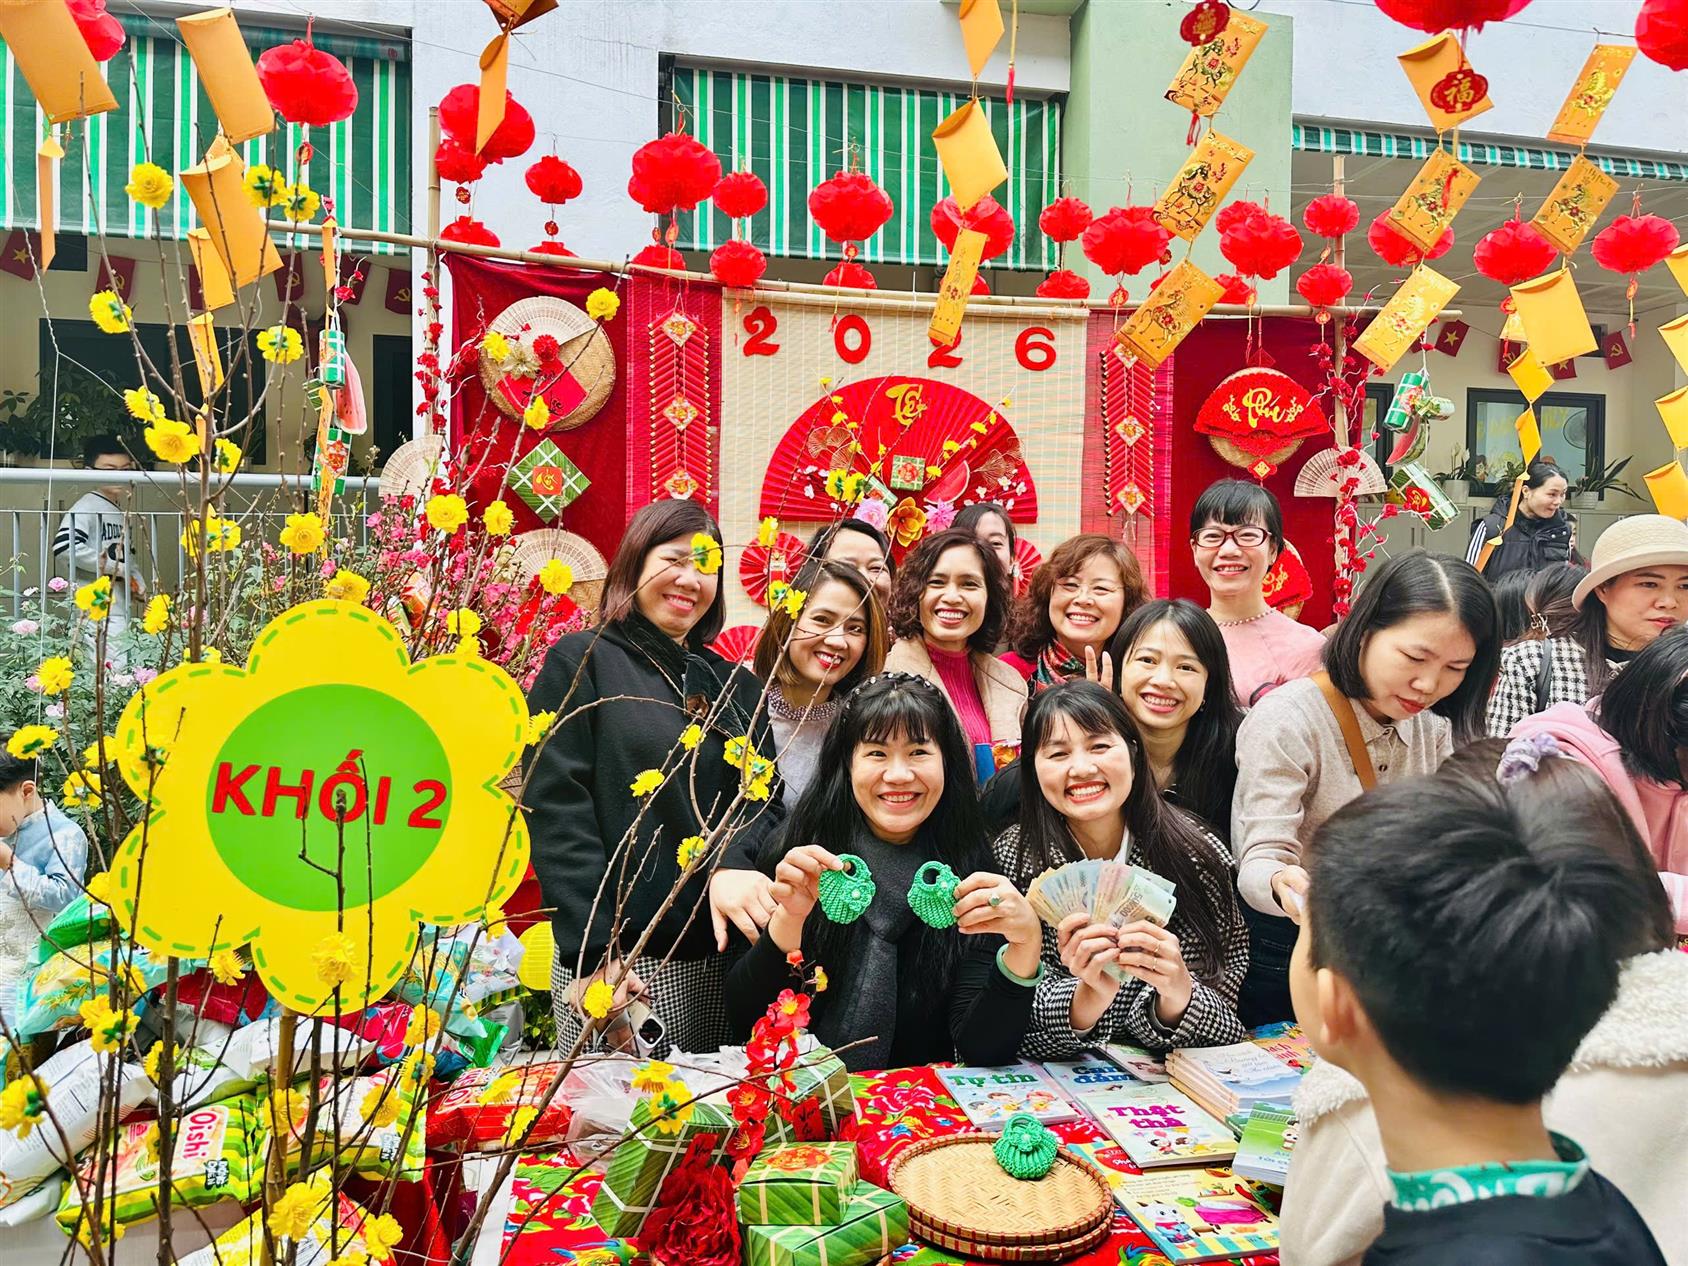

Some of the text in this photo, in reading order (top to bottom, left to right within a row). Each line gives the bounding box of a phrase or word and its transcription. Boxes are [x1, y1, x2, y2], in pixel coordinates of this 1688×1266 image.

[1242, 387, 1286, 428] Phúc
[211, 749, 448, 830] KHỐI 2
[991, 1073, 1039, 1084] tin
[182, 1112, 218, 1160] Oishi
